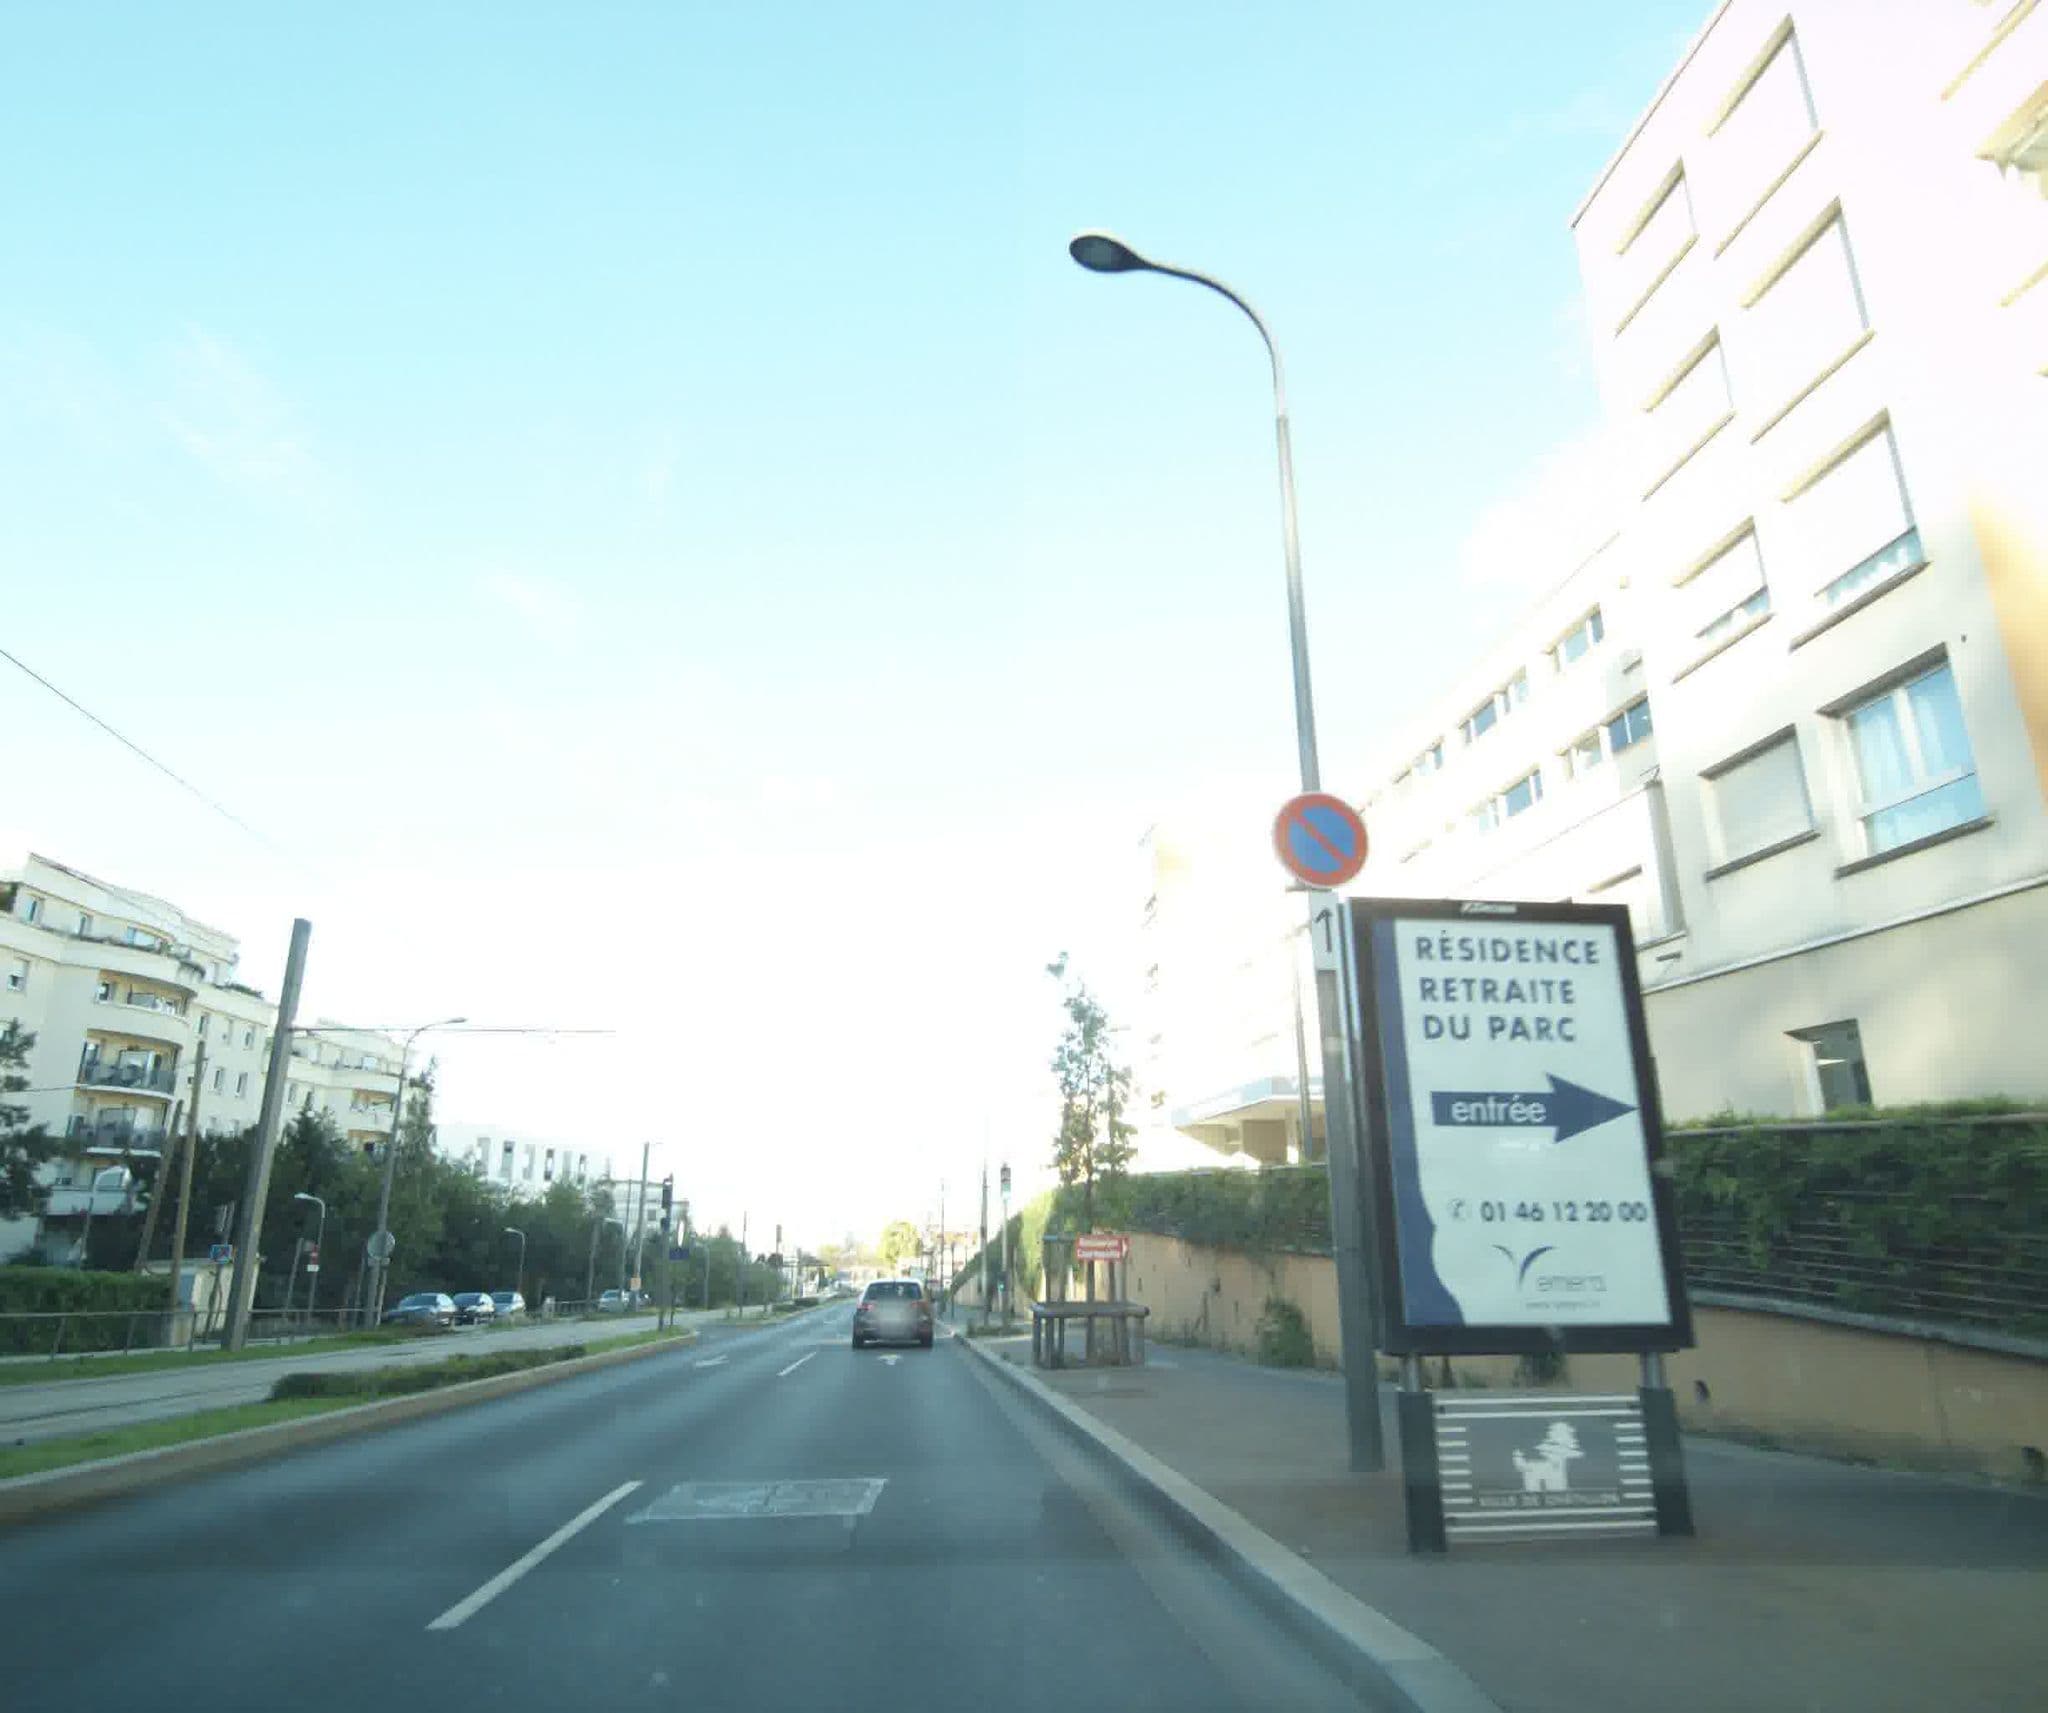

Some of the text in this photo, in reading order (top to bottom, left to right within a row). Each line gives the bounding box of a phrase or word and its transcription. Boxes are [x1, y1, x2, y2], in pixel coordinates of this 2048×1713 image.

[1415, 929, 1600, 964] RÉSIDENCE
[1419, 976, 1576, 1004] RETRAITE
[1424, 1014, 1577, 1042] DU PARC
[1451, 1094, 1547, 1123] entrée
[1480, 1201, 1648, 1222] 01 46 12 20 00
